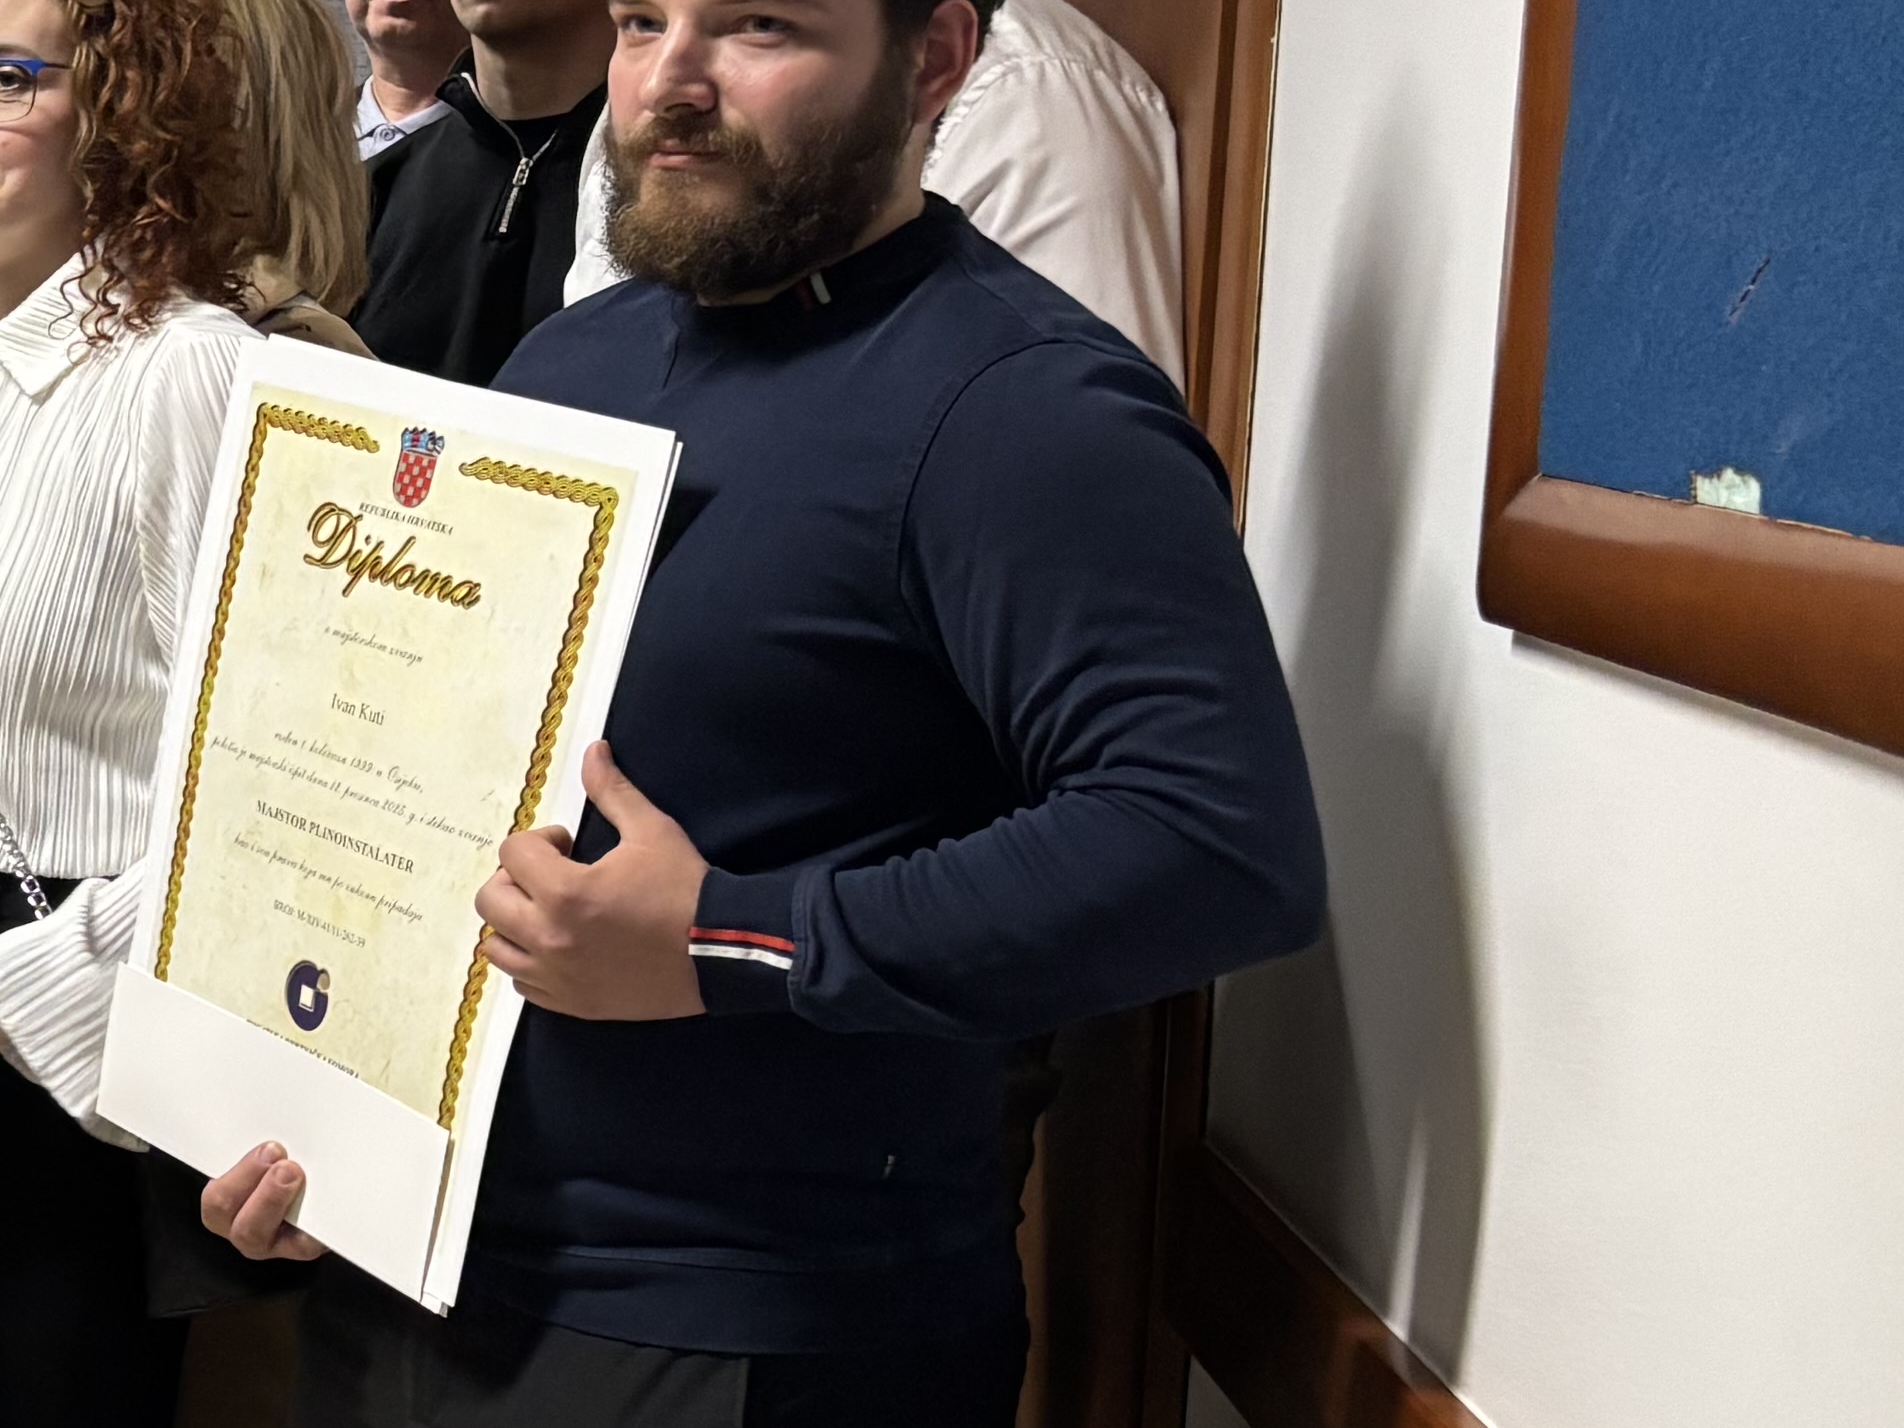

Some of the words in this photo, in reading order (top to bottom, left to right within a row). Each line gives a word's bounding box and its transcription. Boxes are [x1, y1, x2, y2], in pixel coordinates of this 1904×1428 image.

[303, 502, 482, 610] Diploma
[331, 693, 356, 716] Ivan
[256, 800, 307, 832] MAJSTOR
[309, 821, 415, 874] PLINOINSTALATER
